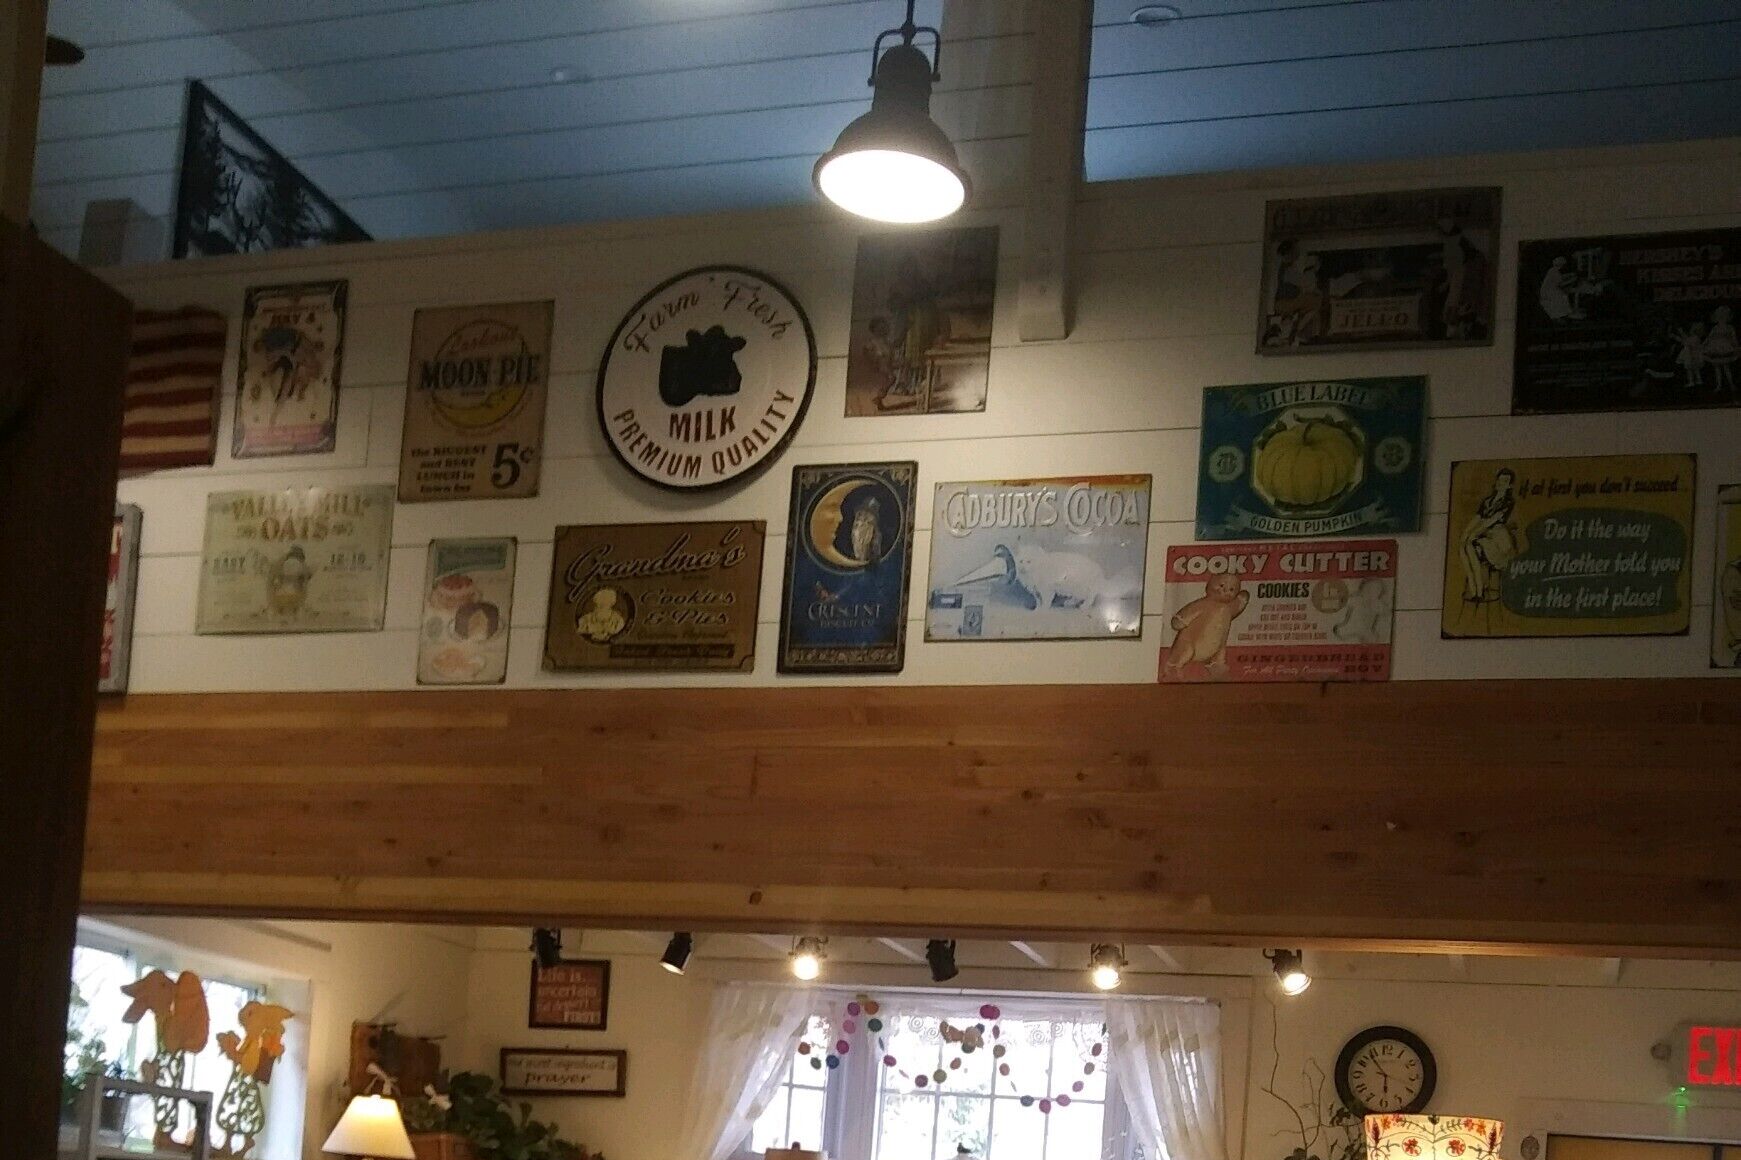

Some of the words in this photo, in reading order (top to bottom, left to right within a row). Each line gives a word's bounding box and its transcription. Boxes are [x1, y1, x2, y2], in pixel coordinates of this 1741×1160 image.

[416, 357, 491, 391] MOON
[500, 353, 541, 386] PIE
[1255, 386, 1306, 412] BLUE
[1309, 384, 1368, 407] LABEL
[613, 408, 702, 479] PREMIUM
[711, 389, 795, 475] QUALITY
[668, 405, 737, 443] MILK
[1063, 482, 1139, 537] COCOA
[1250, 515, 1300, 534] GOLDEN
[1304, 512, 1364, 534] PUMPKIN
[1544, 519, 1564, 541] Do
[1571, 519, 1585, 540] it
[1588, 518, 1613, 539] the
[1617, 522, 1652, 544] way
[567, 526, 748, 602] Grandma's
[1173, 552, 1270, 576] COOKY
[1279, 550, 1390, 574] CUTTER
[1510, 557, 1546, 580] your
[1549, 552, 1611, 574] Mother
[1614, 551, 1647, 573] told
[1651, 555, 1682, 578] you
[638, 588, 737, 606] Cookies
[1257, 582, 1310, 599] COOKIES
[1524, 588, 1545, 609] in
[1547, 586, 1572, 609] the
[1576, 586, 1609, 612] first
[1612, 585, 1664, 613] place!
[670, 607, 730, 626] Pies
